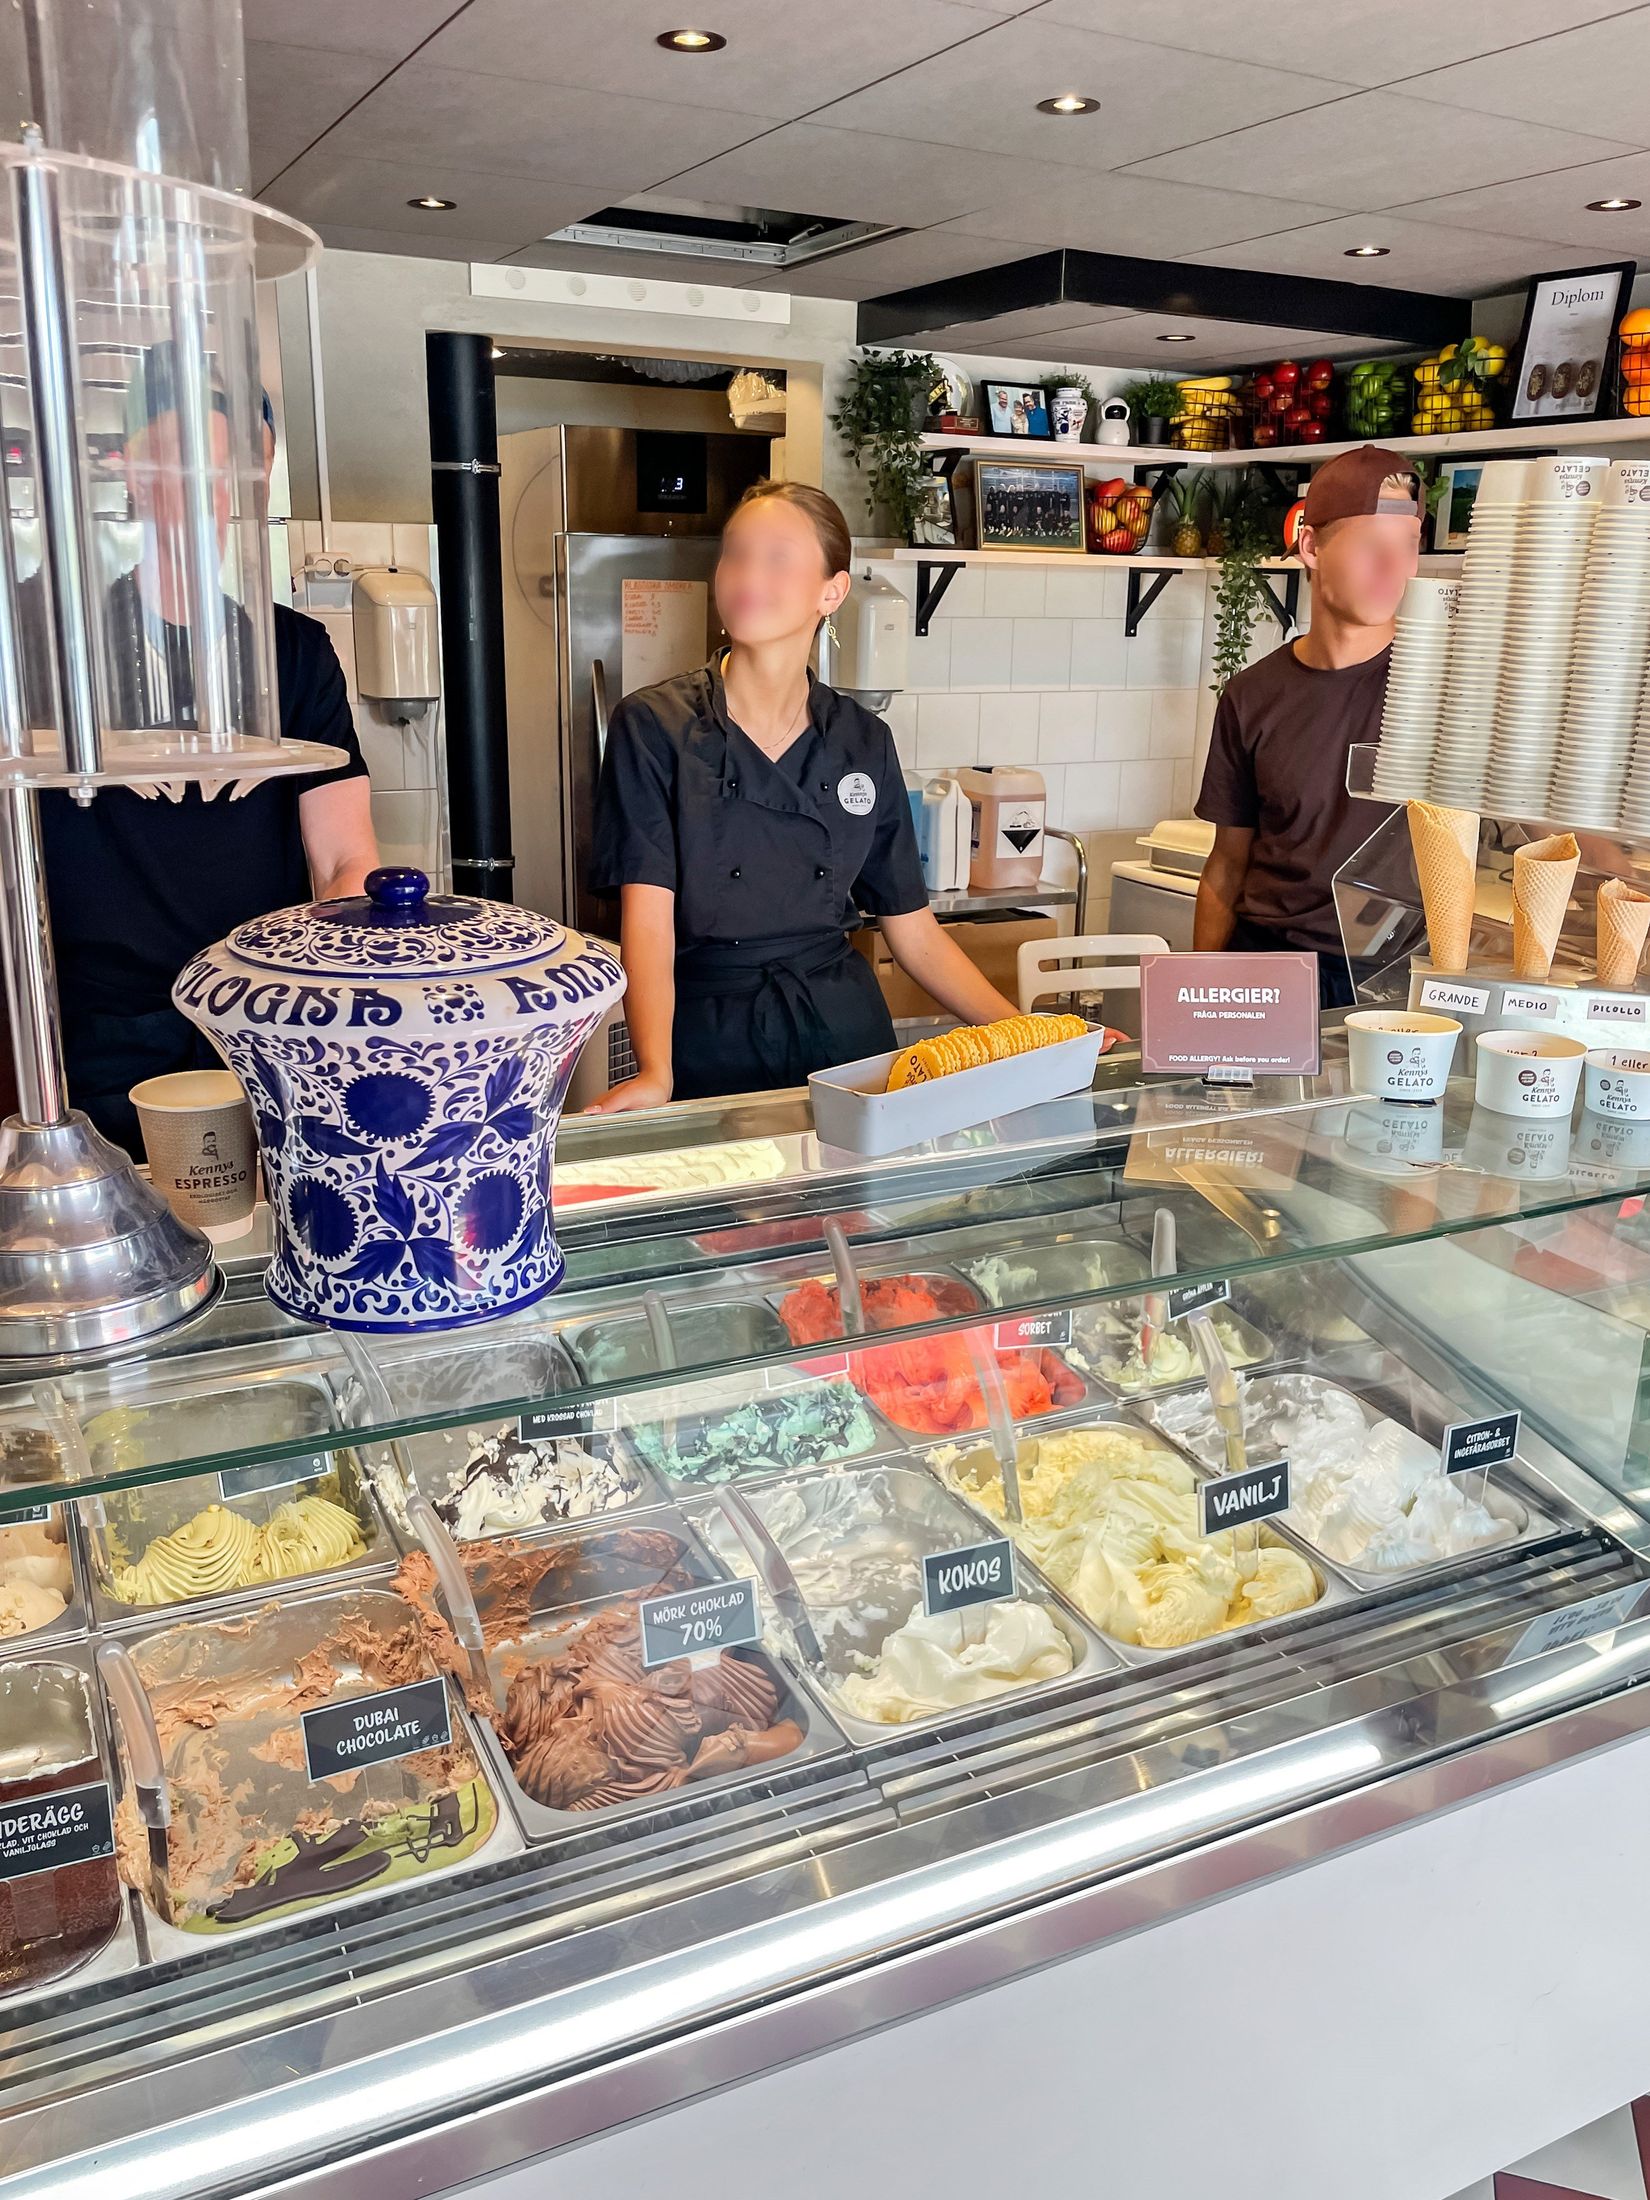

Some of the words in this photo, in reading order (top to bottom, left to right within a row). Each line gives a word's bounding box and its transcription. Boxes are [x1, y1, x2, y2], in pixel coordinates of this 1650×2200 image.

[1551, 288, 1604, 308] Diplom
[1554, 465, 1591, 473] GELATO
[1620, 469, 1650, 477] ELATO
[1438, 588, 1459, 596] LATO
[1177, 987, 1281, 1004] ALLERGIER?
[1429, 990, 1480, 1008] GRANDE
[1508, 999, 1547, 1011] MEDIO
[1593, 1004, 1641, 1016] PICOLLO
[1193, 1010, 1217, 1019] FRÅGA
[1218, 1011, 1266, 1020] PERSONALEN
[1222, 1055, 1234, 1063] Ask
[1270, 1056, 1290, 1064] order!
[1611, 1055, 1617, 1066] 1
[1621, 1058, 1649, 1070] eller
[1398, 1068, 1428, 1077] Kennys
[1387, 1077, 1434, 1087] GELATO
[1522, 1094, 1560, 1103] GELATO
[1599, 1099, 1638, 1112] GELATO
[189, 1160, 234, 1176] Kennys
[175, 1170, 247, 1190] ESPRESSO
[1017, 1321, 1052, 1336] SORBET
[532, 1414, 546, 1424] MED
[547, 1411, 575, 1422] KROSSAD
[1466, 1430, 1493, 1444] CITRON-
[1494, 1427, 1501, 1438] &
[1213, 1474, 1282, 1517] VANILJ
[938, 1556, 1001, 1595] KOKOS
[653, 1605, 686, 1625] MÖRK
[690, 1591, 745, 1616] CHOKLAD
[680, 1615, 722, 1646] 70%
[353, 1707, 399, 1732] DUBAI
[336, 1720, 422, 1756] CHOCOLATE
[22, 1835, 35, 1845] VIT
[37, 1826, 72, 1841] CHOKLAD
[73, 1823, 89, 1832] OCH
